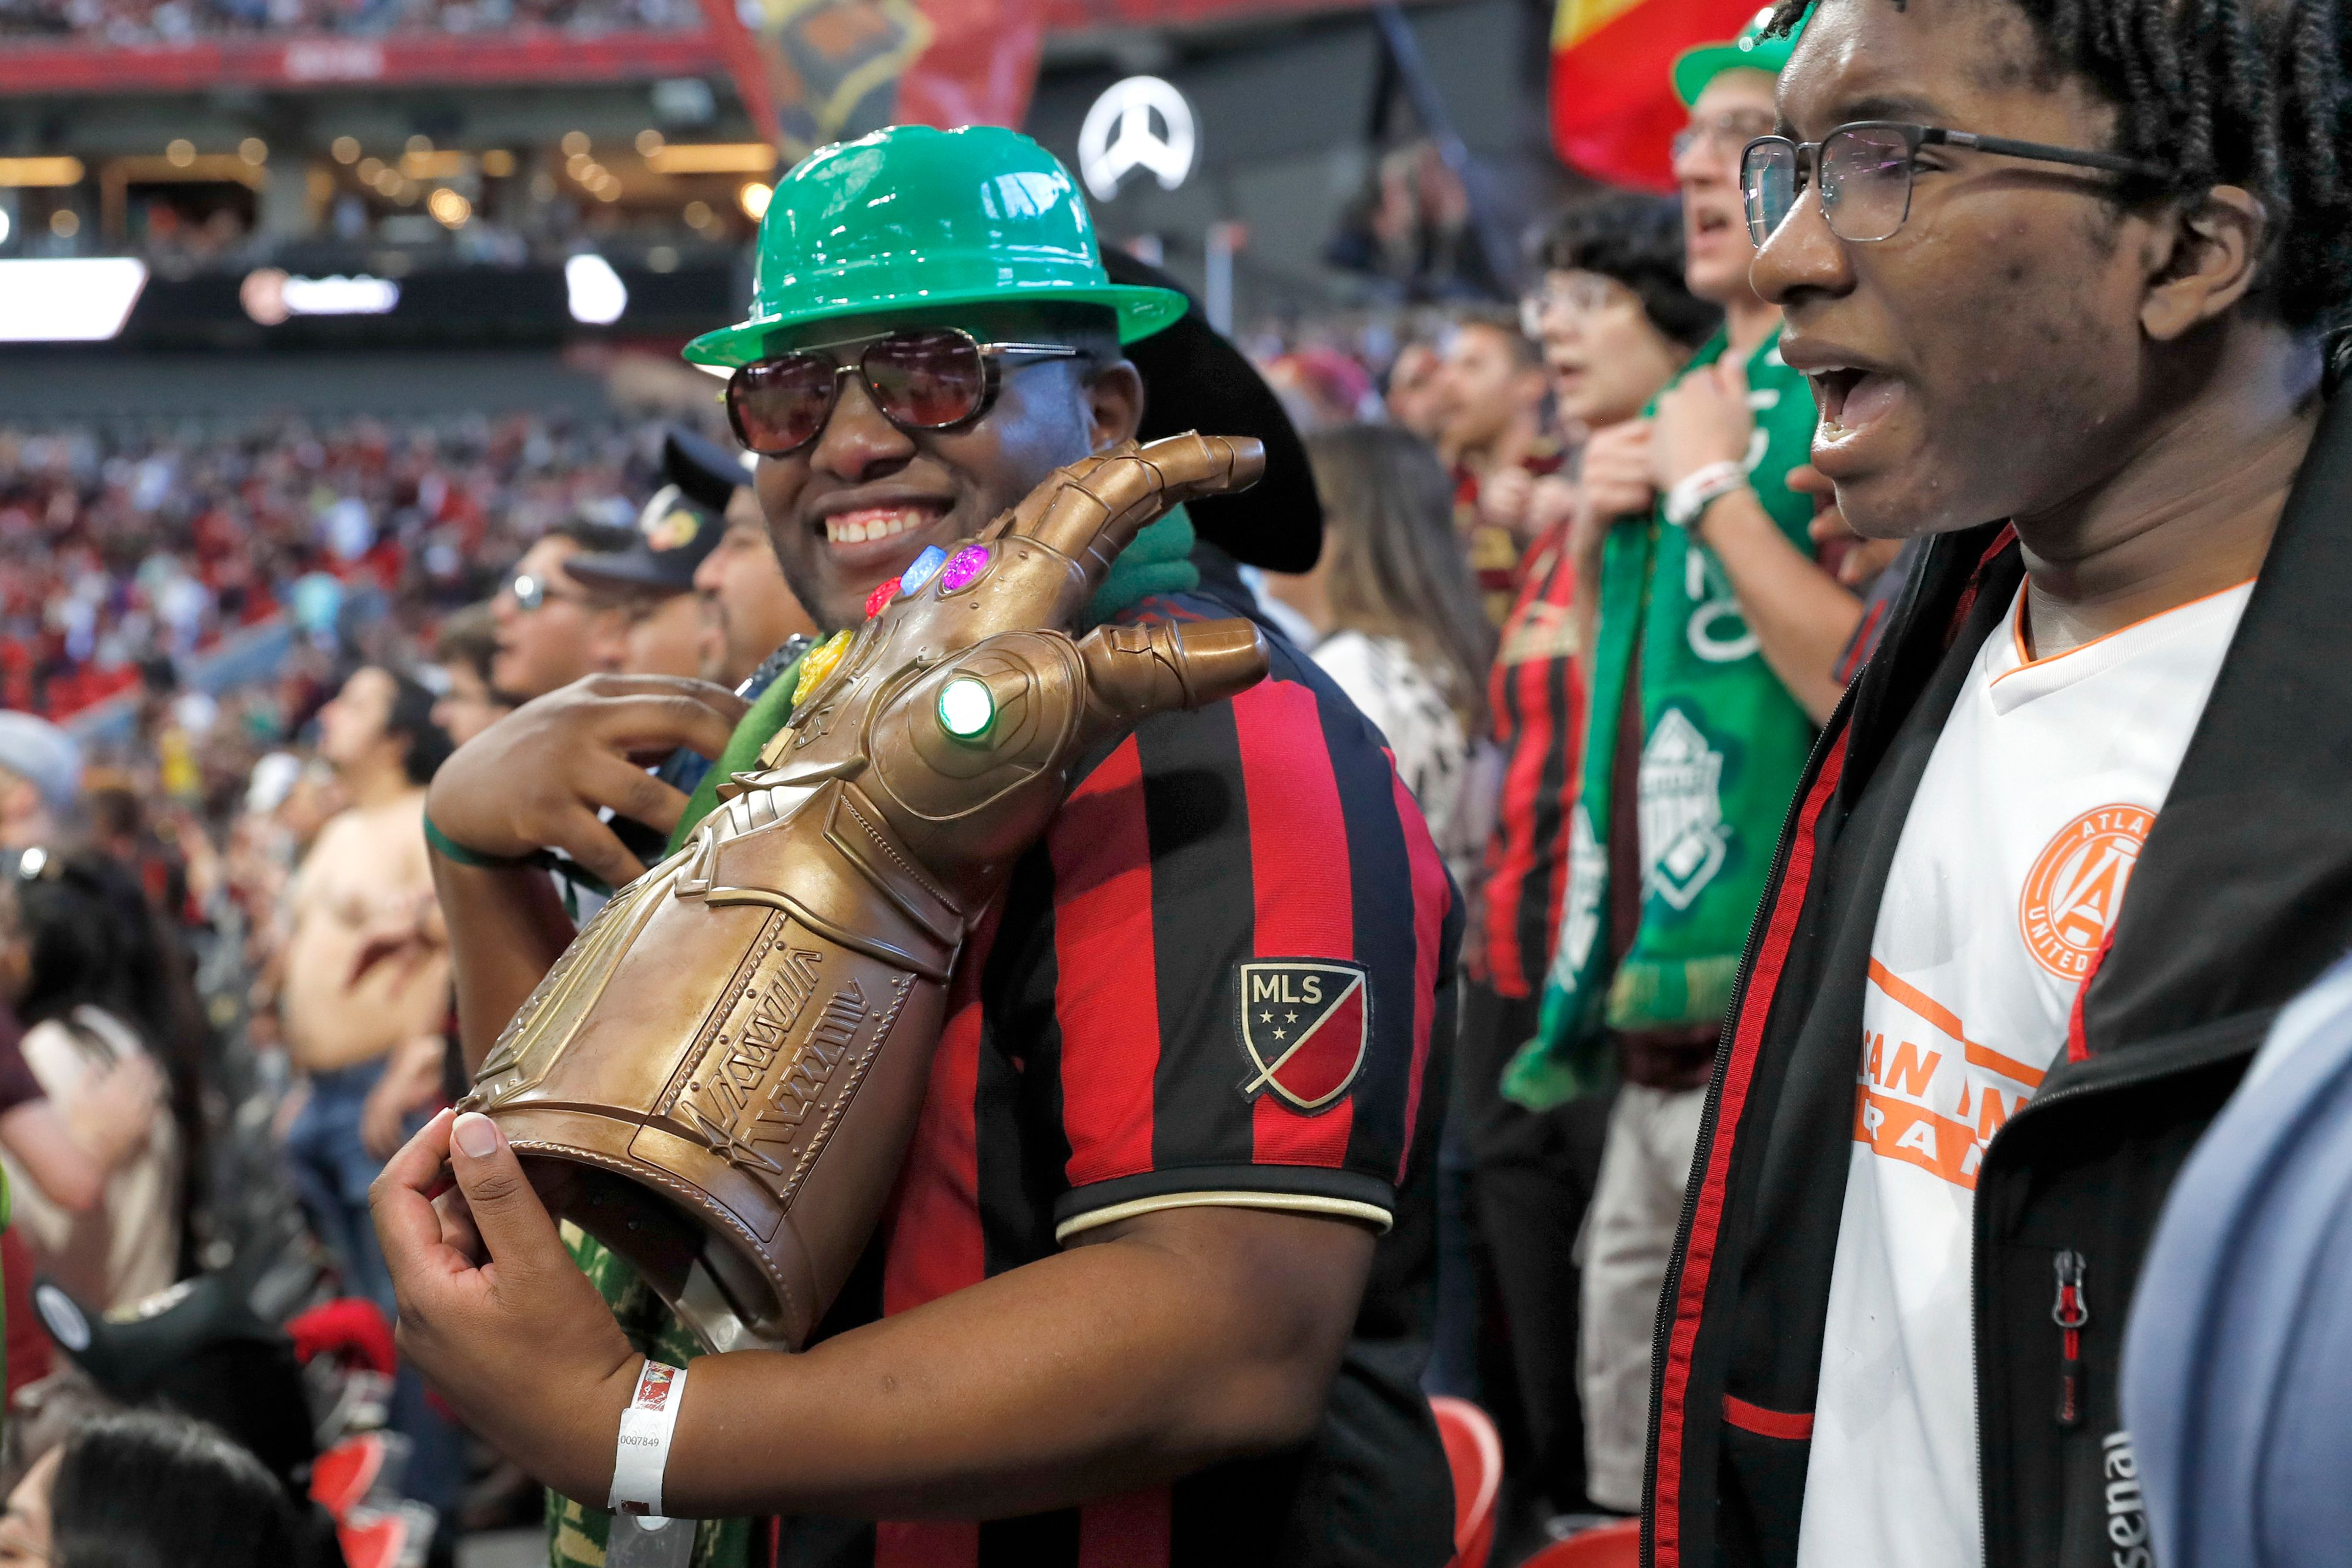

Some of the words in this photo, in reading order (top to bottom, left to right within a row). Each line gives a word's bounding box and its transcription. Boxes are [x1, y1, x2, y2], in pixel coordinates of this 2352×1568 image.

[2083, 813, 2147, 839] ATLA
[2029, 905, 2088, 972] UNITED
[1253, 974, 1322, 1004] MLS
[620, 1435, 659, 1447] 0007849
